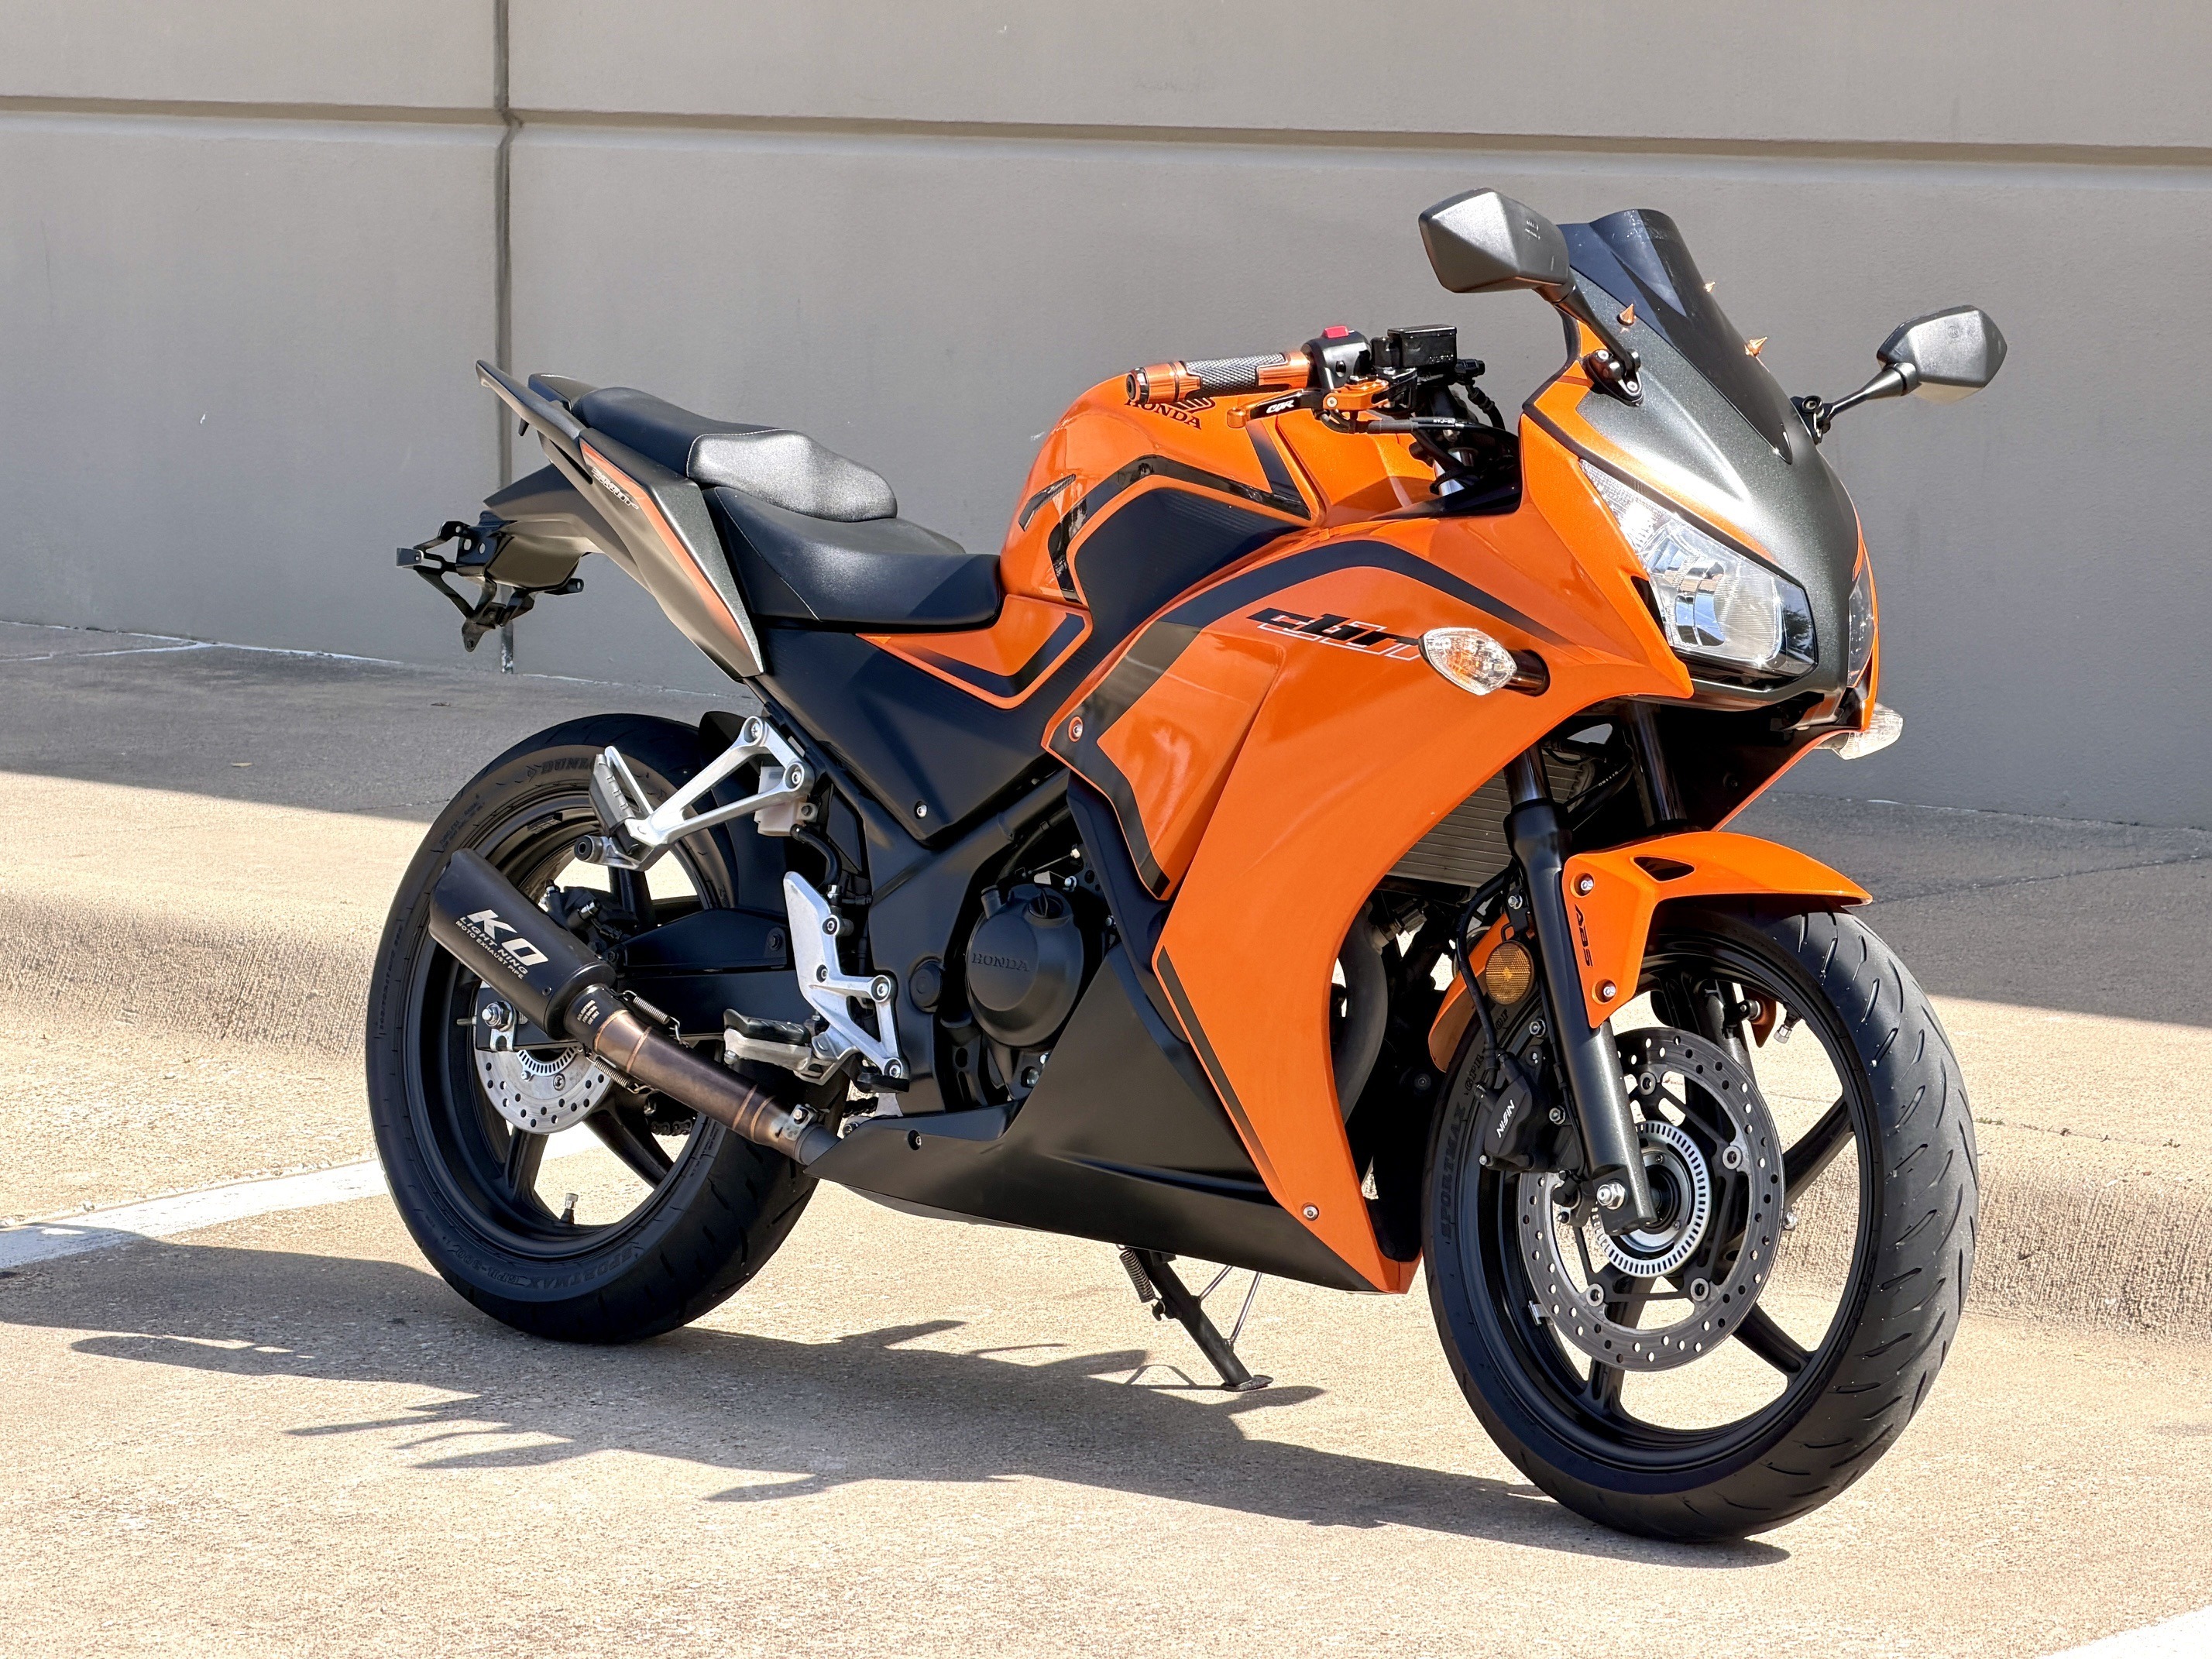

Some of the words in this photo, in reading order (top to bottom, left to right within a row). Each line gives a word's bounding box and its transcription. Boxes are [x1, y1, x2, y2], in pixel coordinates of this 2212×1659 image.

[541, 757, 595, 775] DUNL
[455, 920, 476, 939] MOTO
[476, 937, 508, 965] EXHAUST
[507, 965, 524, 980] PIPE
[1575, 904, 1593, 967] ABS
[971, 953, 1031, 972] HONDA
